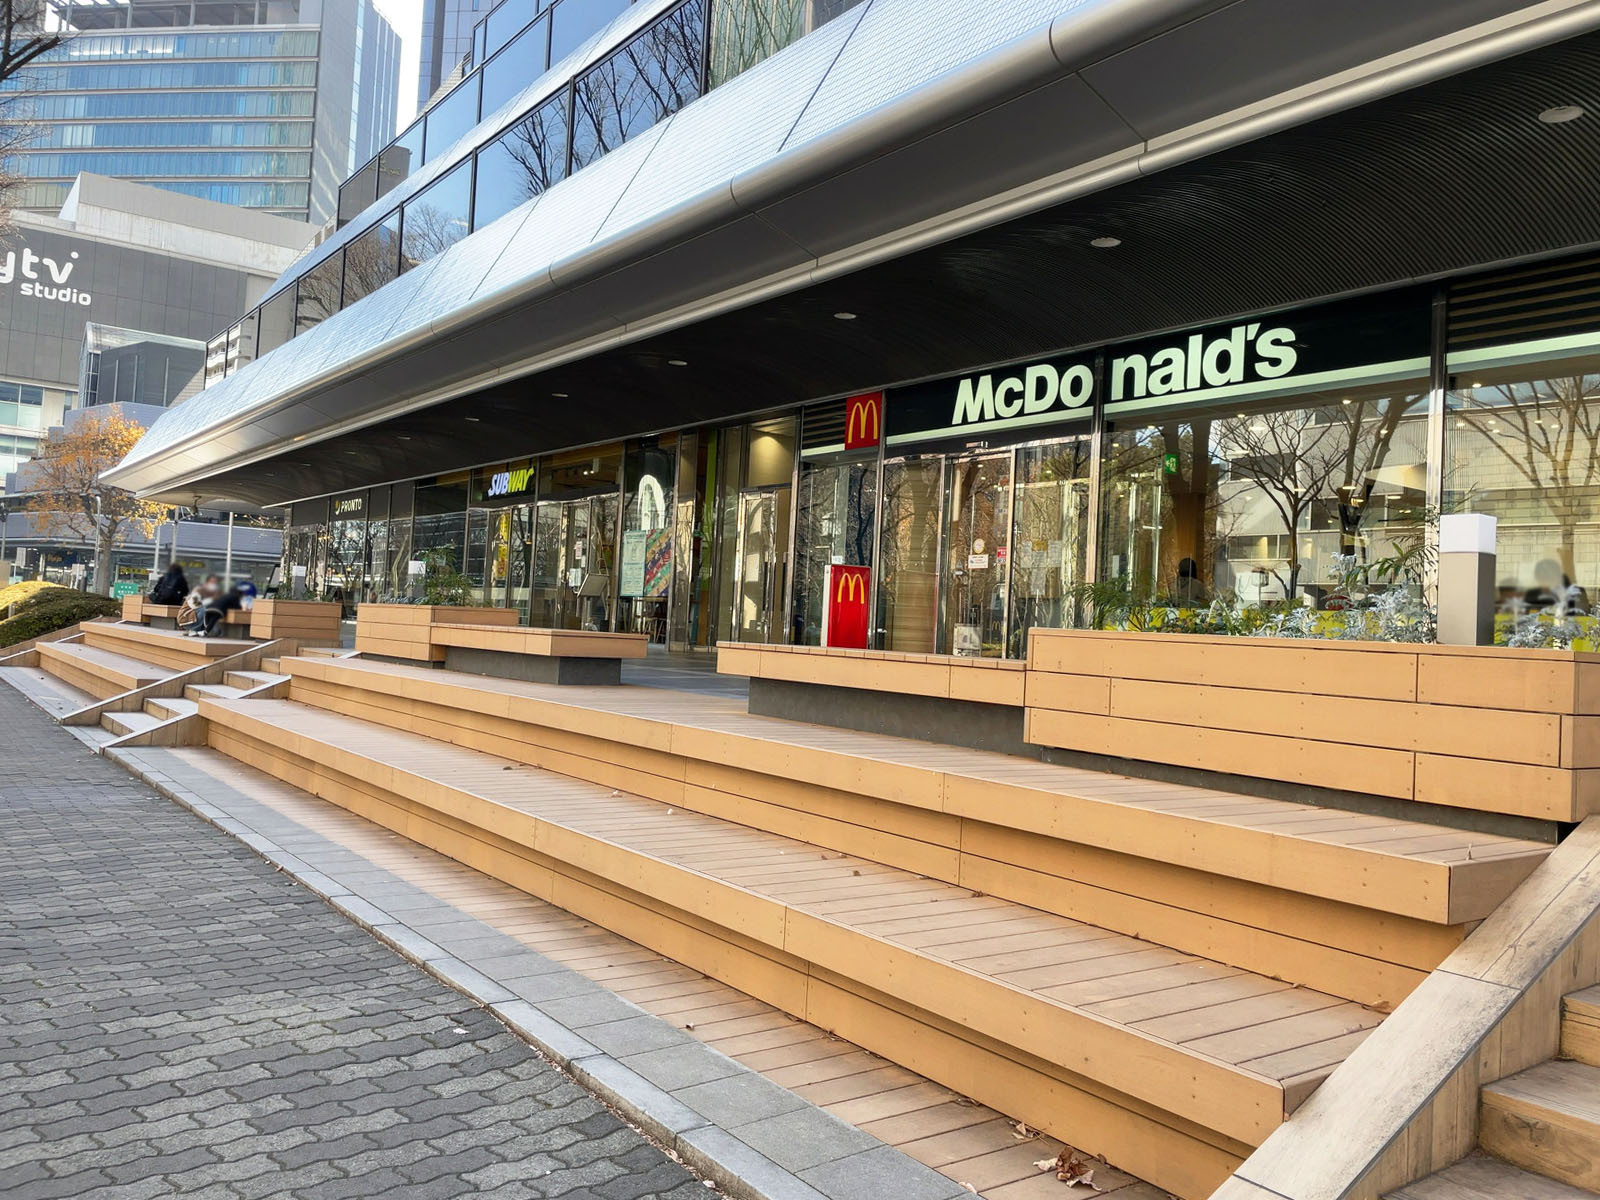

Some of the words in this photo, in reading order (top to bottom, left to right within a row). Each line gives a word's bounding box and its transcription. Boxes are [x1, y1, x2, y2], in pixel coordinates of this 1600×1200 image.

[20, 282, 92, 306] studio
[487, 466, 535, 497] SUBWAY
[340, 498, 362, 513] PRONTO
